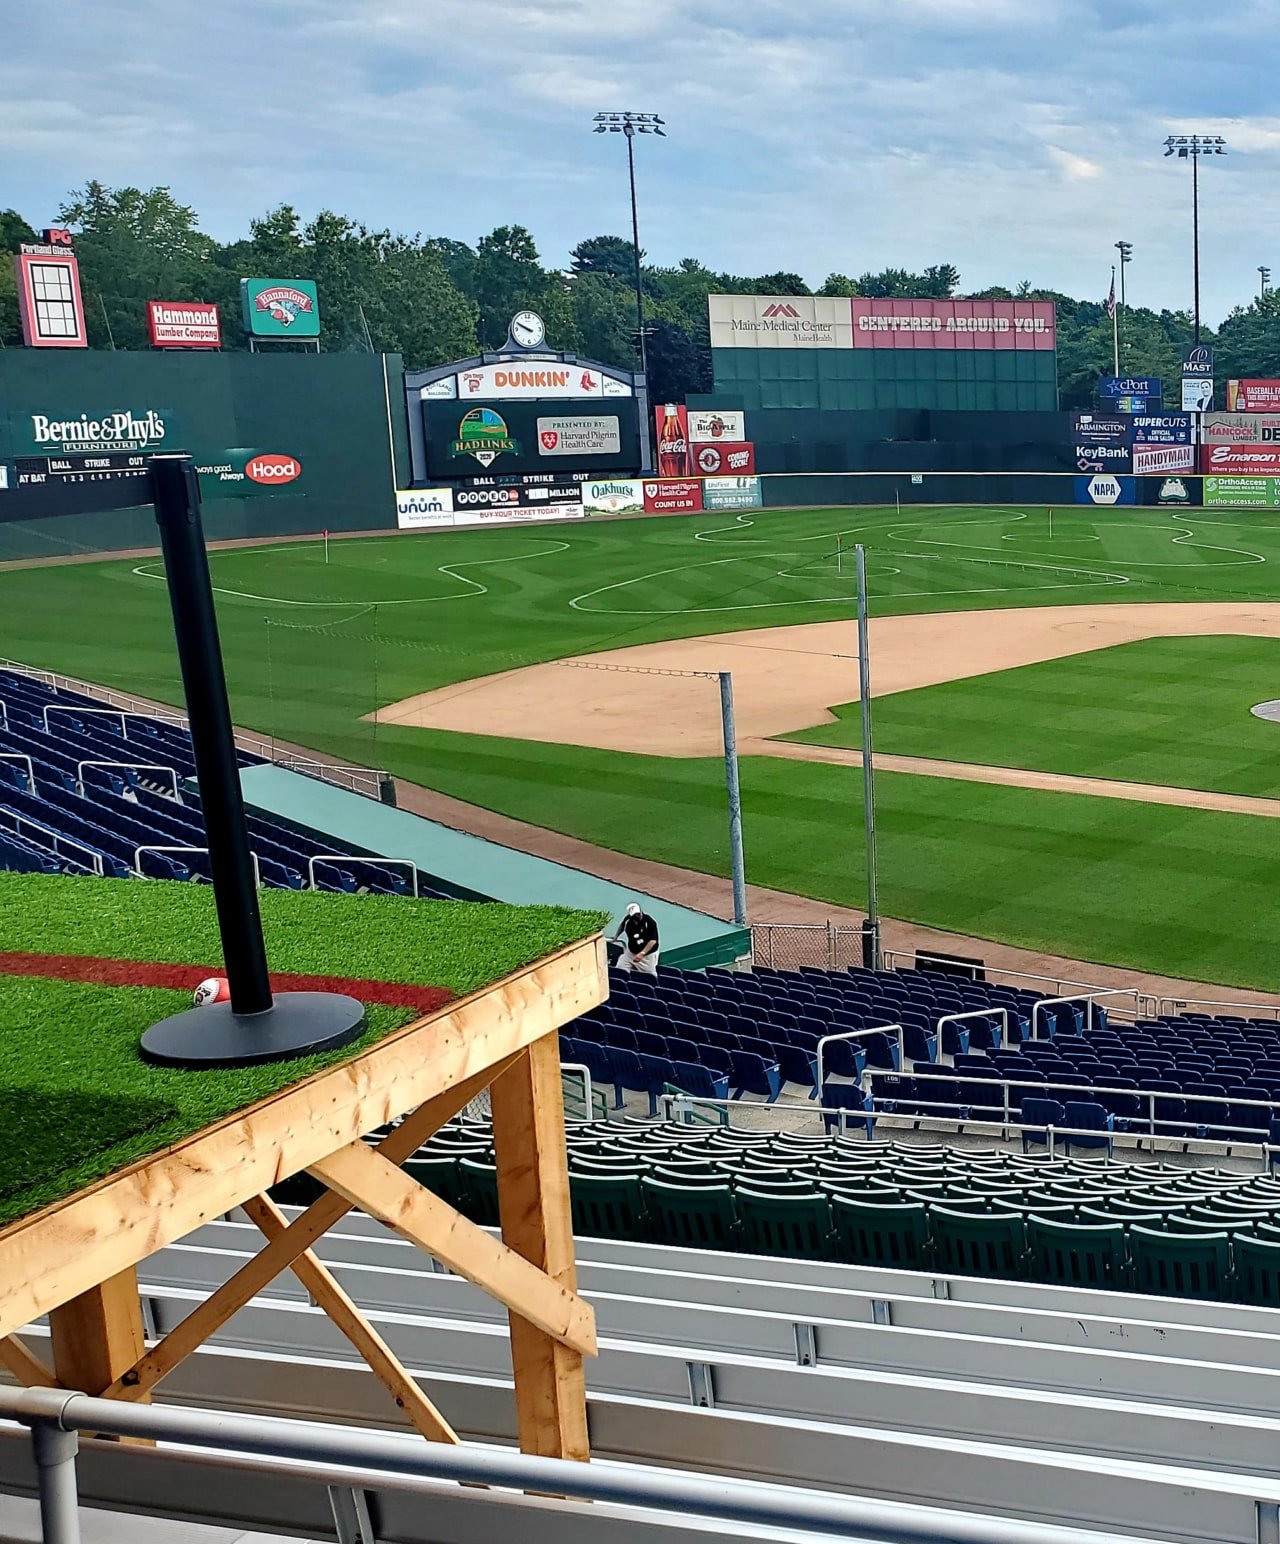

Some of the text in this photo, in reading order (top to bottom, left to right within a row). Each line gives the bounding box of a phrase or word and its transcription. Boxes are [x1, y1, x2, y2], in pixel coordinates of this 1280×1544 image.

[49, 229, 72, 245] PG
[260, 289, 308, 306] Hannaford
[152, 305, 218, 325] Hammond
[731, 319, 832, 333] Maine Medical Center
[858, 316, 1050, 334] CENTERED AROUND YOU.
[156, 326, 218, 340] Lumber Company
[793, 334, 833, 342] MaineHealth
[1182, 363, 1212, 372] MAST
[494, 371, 570, 388] DUNKIN'
[1119, 379, 1149, 391] cPort
[1246, 387, 1274, 395] BASEBALL
[552, 421, 592, 429] PRESENTED
[1075, 422, 1126, 432] FARMINGTON
[1133, 417, 1188, 428] SUPERCUTS
[560, 431, 617, 442] Harvard Pilgrim
[1208, 427, 1254, 436] HANCOCK
[65, 441, 135, 451] FURNITURE
[455, 440, 515, 451] HADLINKS
[727, 450, 750, 462] COMING
[1076, 446, 1129, 459] KeyBank
[1137, 448, 1190, 469] HANDYMAN
[1210, 446, 1276, 463] Emerson
[51, 457, 144, 470] BALL STRIKE OUT
[252, 461, 296, 478] Hood
[19, 473, 47, 484] AT BAT
[220, 472, 245, 481] Always
[473, 473, 590, 486] BALL STRIKE OUT
[1218, 478, 1267, 486] OrthoAccess
[549, 488, 580, 497] MILLION
[591, 483, 634, 499] Oakhurst
[1094, 483, 1116, 496] NAPA
[398, 498, 442, 514] unum
[654, 501, 675, 509] COUNT
[676, 500, 685, 508] US
[1207, 497, 1267, 505] ortho-access.com
[479, 511, 493, 519] BUY
[494, 510, 513, 518] YOUR
[513, 509, 536, 517] TICKET
[537, 507, 560, 515] TODAY!
